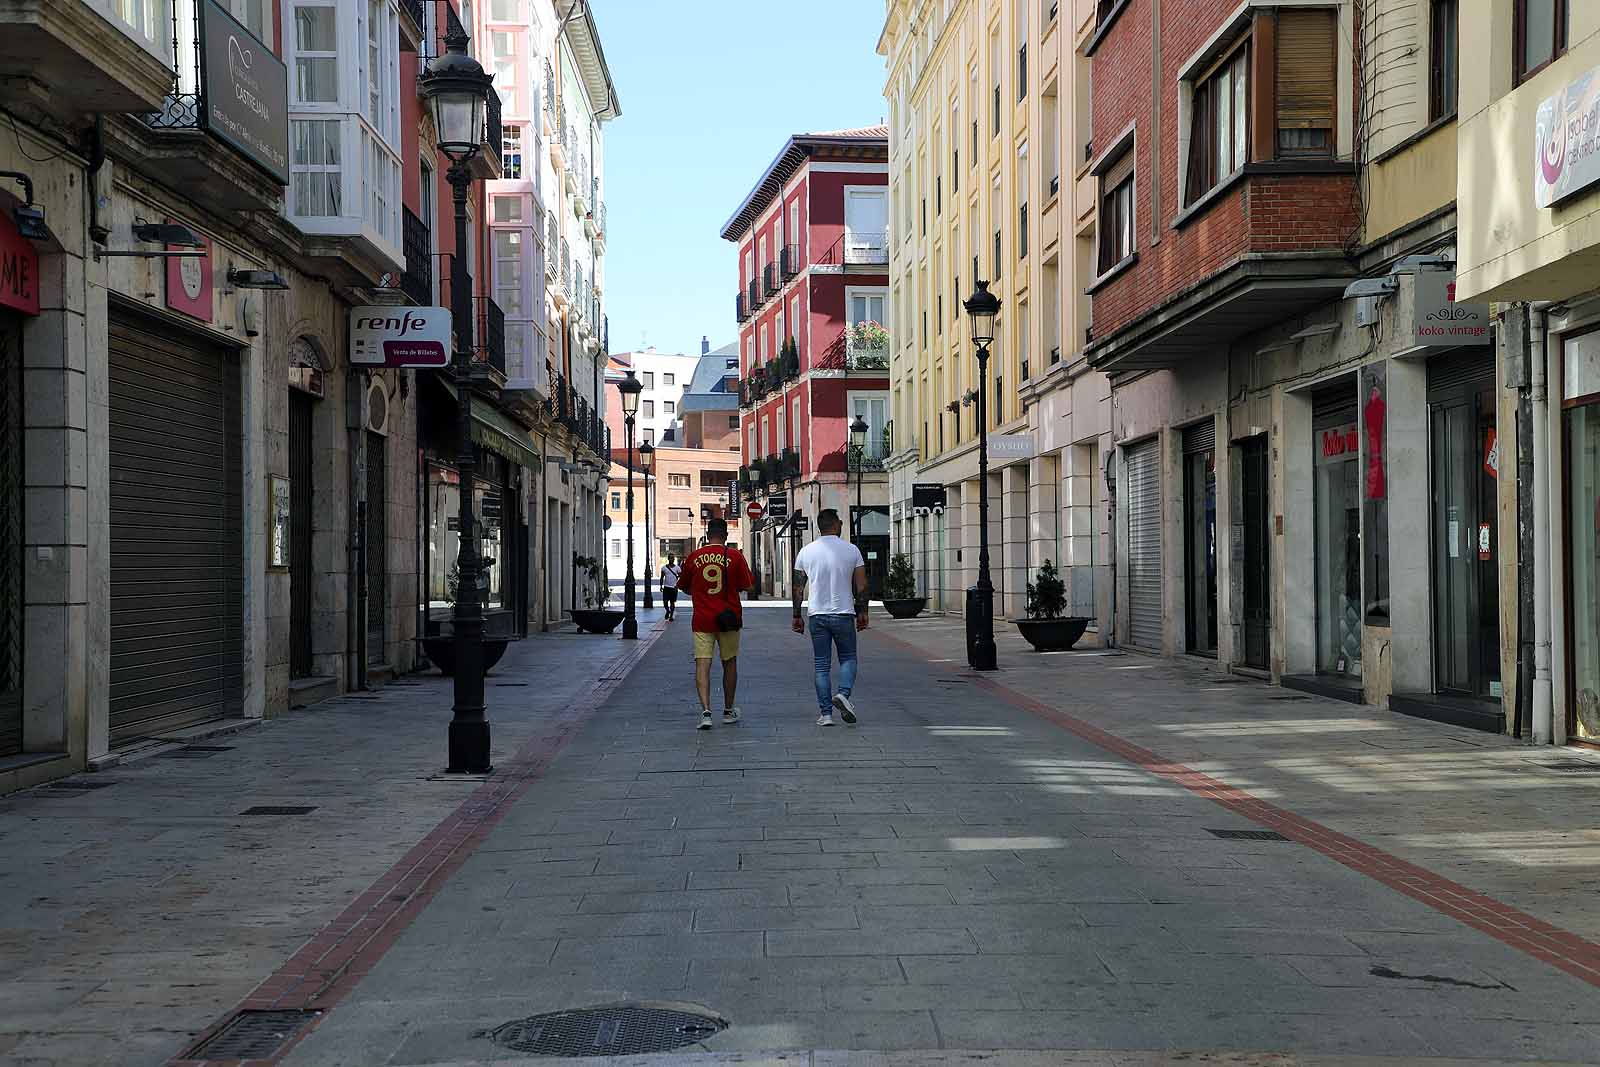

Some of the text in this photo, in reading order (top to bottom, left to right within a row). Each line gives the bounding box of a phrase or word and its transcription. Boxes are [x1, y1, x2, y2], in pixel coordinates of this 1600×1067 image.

[356, 311, 426, 336] renfe
[1419, 325, 1485, 337] koko vintage
[393, 348, 408, 356] Venta
[409, 348, 416, 356] de
[703, 565, 722, 594] 9
